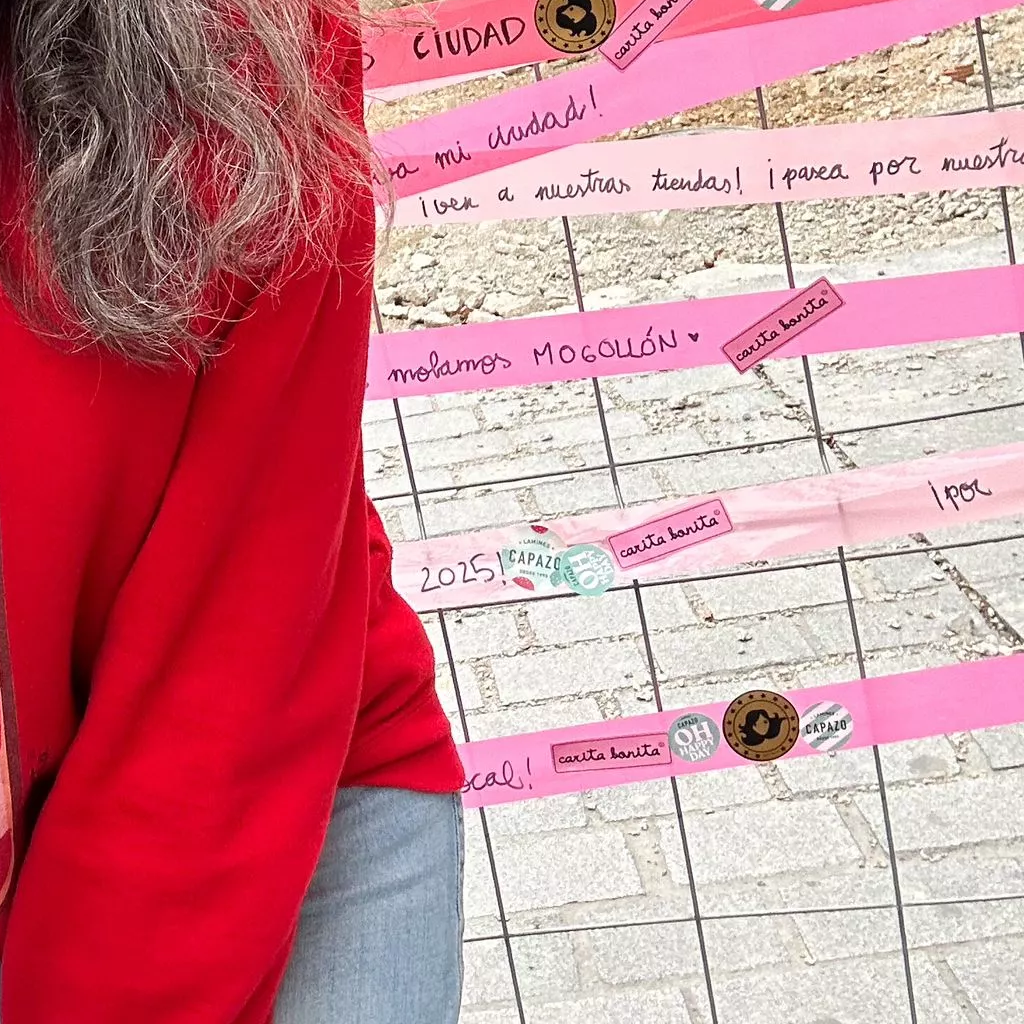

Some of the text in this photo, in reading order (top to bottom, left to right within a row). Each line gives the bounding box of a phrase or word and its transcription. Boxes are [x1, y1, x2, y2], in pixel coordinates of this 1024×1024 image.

[413, 16, 526, 60] CIUDAD
[614, 20, 654, 61] carita
[435, 140, 472, 171] mi
[498, 186, 514, 202] a
[535, 168, 632, 201] nuestras
[652, 167, 743, 195] tiendas!
[869, 155, 921, 186] por
[736, 295, 829, 362] carita bonita
[387, 351, 512, 384] molamos
[619, 513, 720, 559] carita bonita
[421, 551, 507, 593] 2025!
[508, 549, 561, 571] CAPAZO
[568, 551, 599, 589] OH
[674, 721, 714, 747] OH
[805, 719, 847, 735] CAPAZO
[558, 744, 661, 765] carita bonita
[678, 736, 715, 756] HAPPY
[690, 747, 712, 762] DAY
